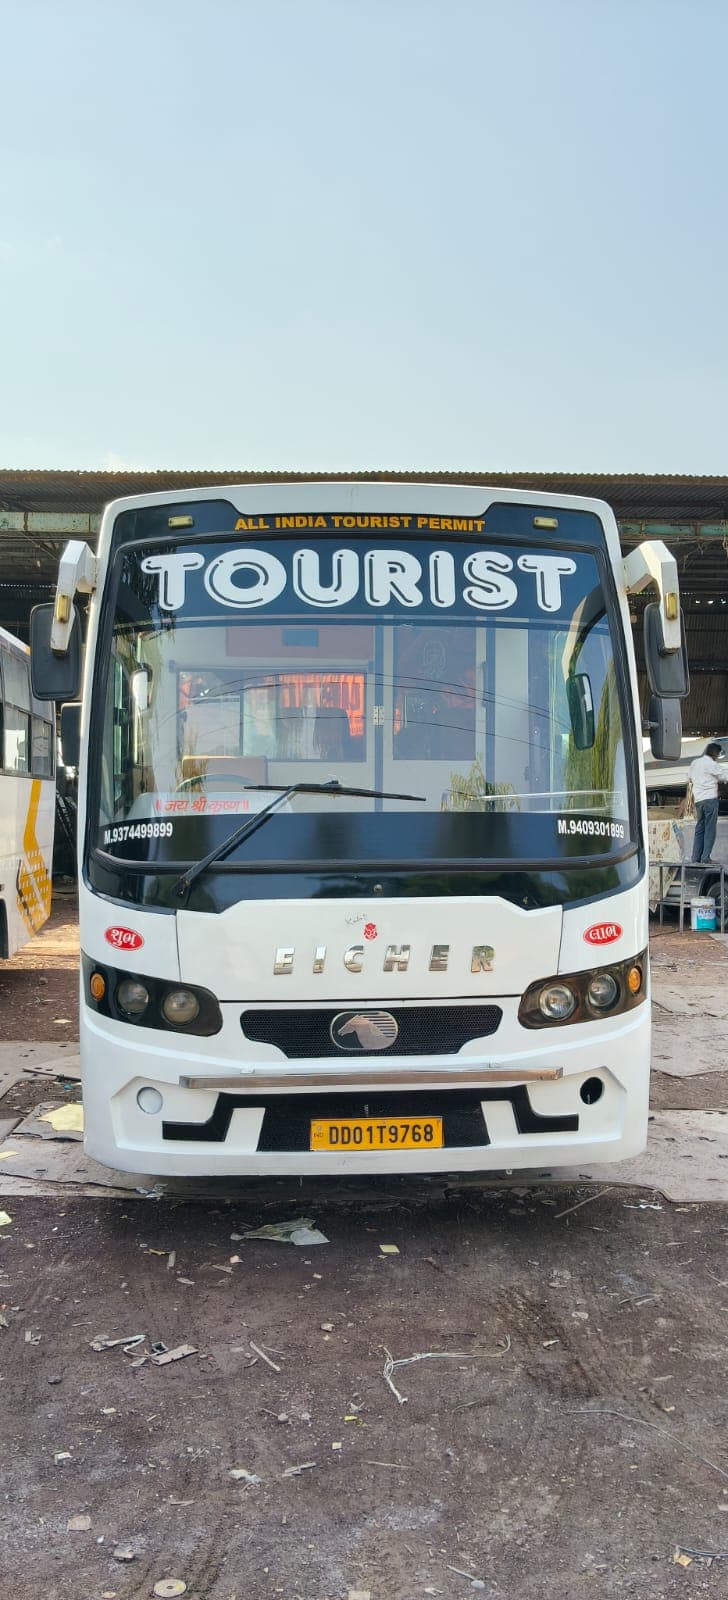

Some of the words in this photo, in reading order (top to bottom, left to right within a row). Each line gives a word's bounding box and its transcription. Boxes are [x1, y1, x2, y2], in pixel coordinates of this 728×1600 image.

[235, 518, 269, 531] ALL
[275, 516, 327, 528] INDIA
[331, 516, 412, 528] TOURIST
[417, 517, 485, 532] PERMIT
[140, 549, 577, 613] TOURIST
[191, 796, 207, 811] श्री
[104, 822, 173, 844] M.9374499899
[557, 820, 624, 838] M.9409301899
[273, 944, 494, 975] EICHER
[329, 1123, 433, 1145] DD01T9768
